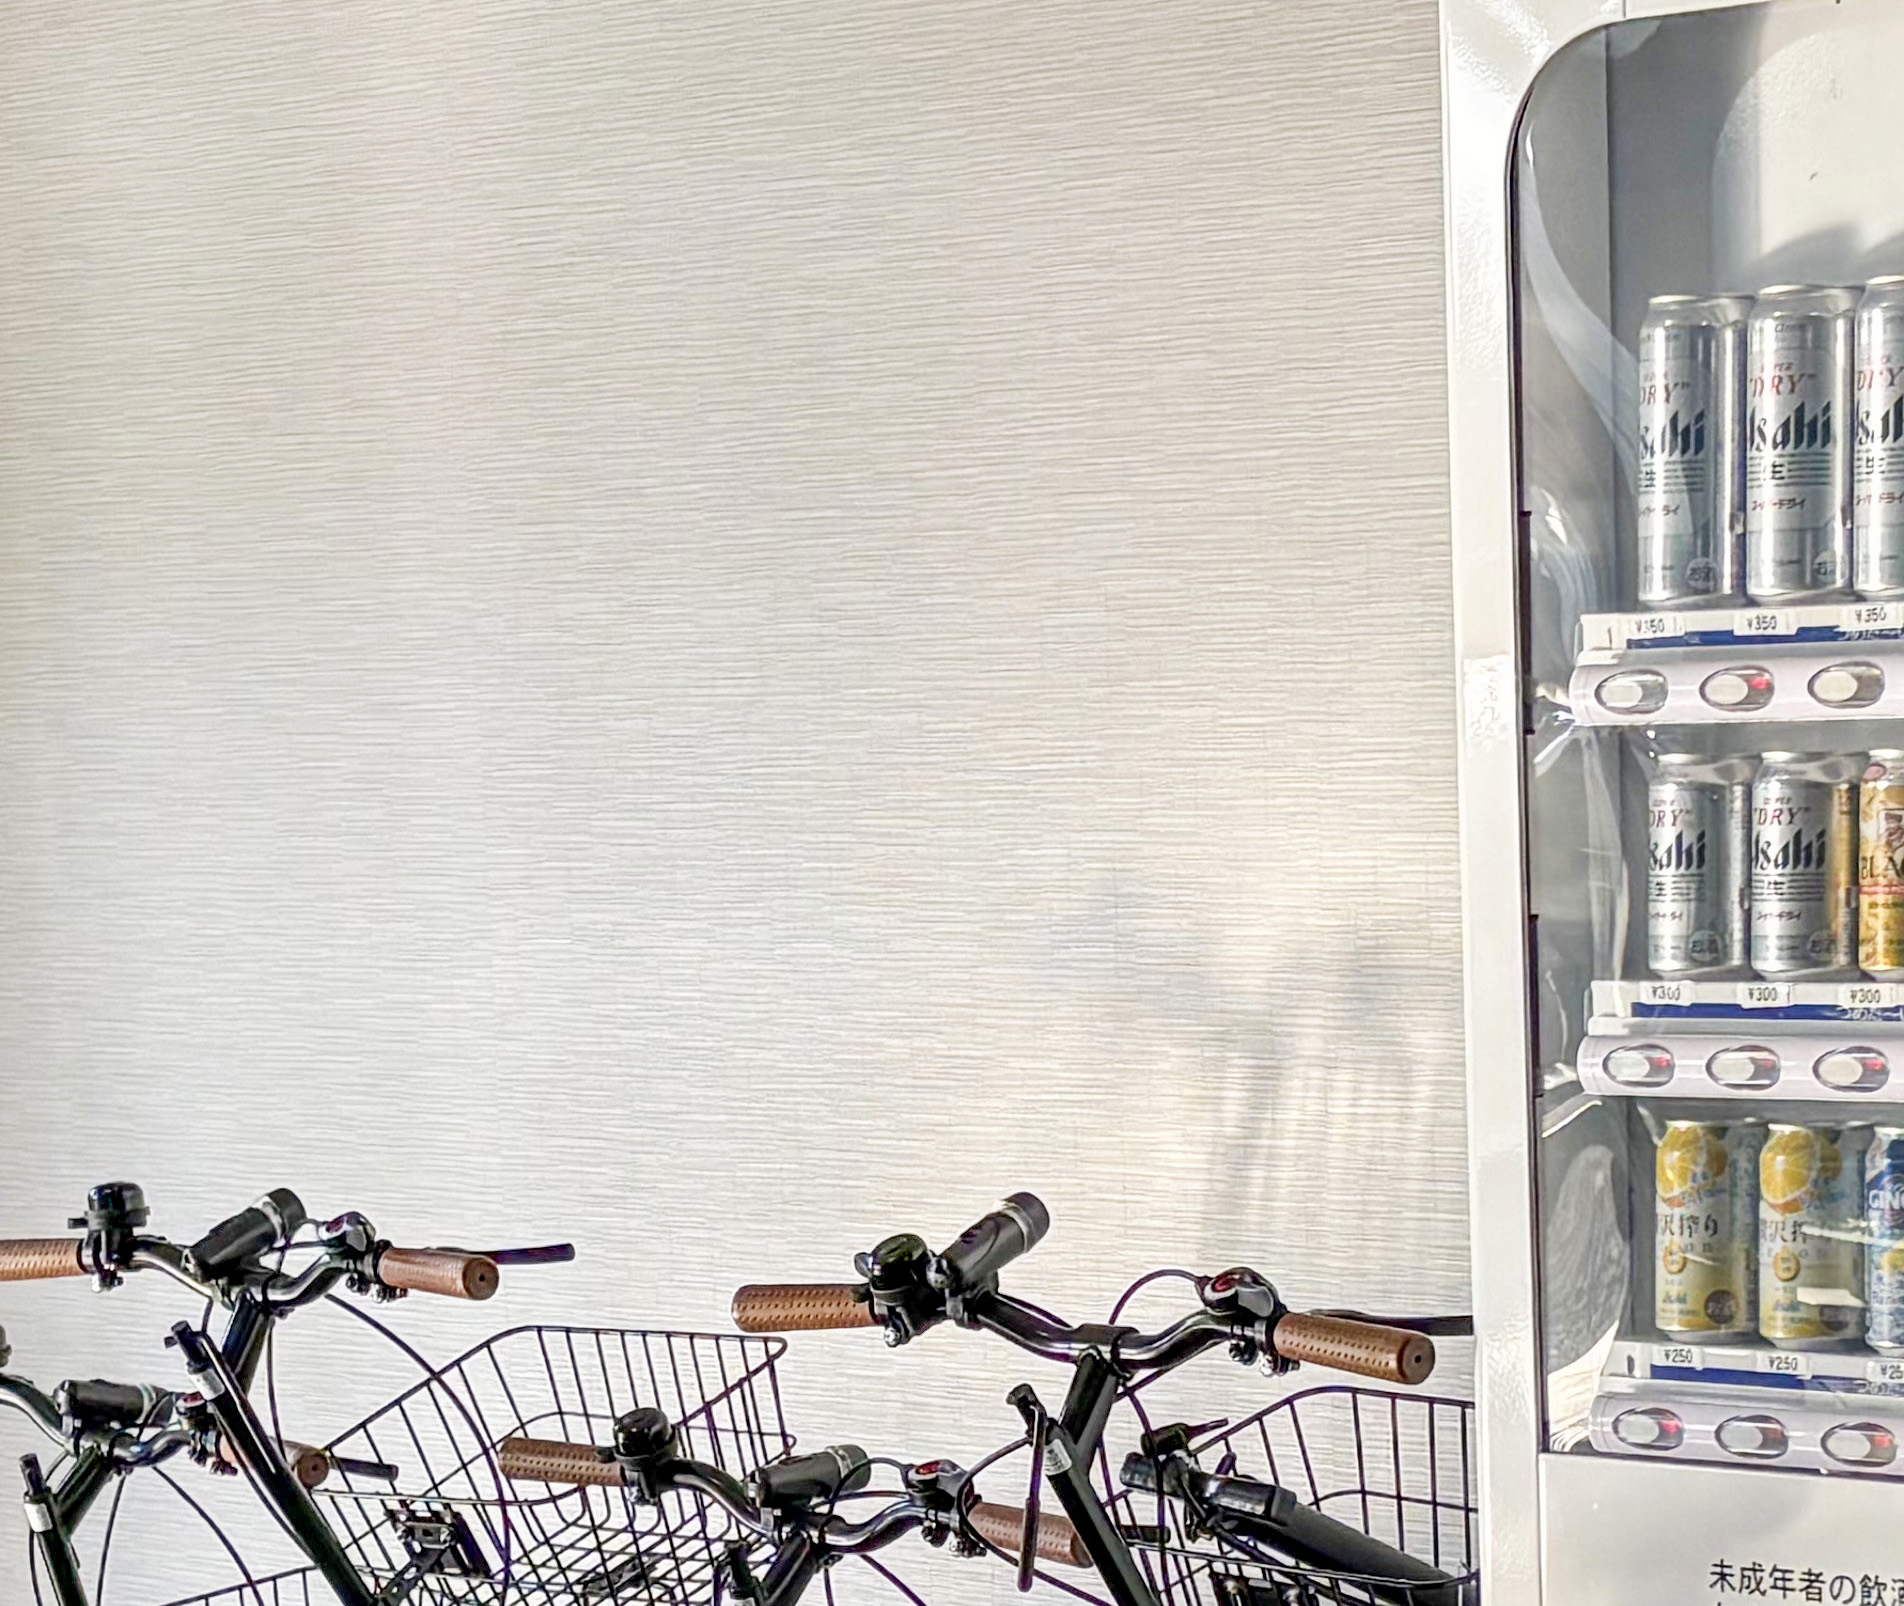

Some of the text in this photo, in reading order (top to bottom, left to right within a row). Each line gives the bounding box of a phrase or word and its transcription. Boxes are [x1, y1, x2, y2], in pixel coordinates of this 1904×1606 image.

[1855, 606, 1887, 623] ¥350
[1746, 615, 1777, 631] ¥350
[1652, 985, 1681, 1000] ¥300
[1748, 985, 1778, 1001] ¥300
[1850, 987, 1882, 1004] ¥300
[1664, 1348, 1694, 1364] ¥250
[1767, 1355, 1799, 1372] ¥250
